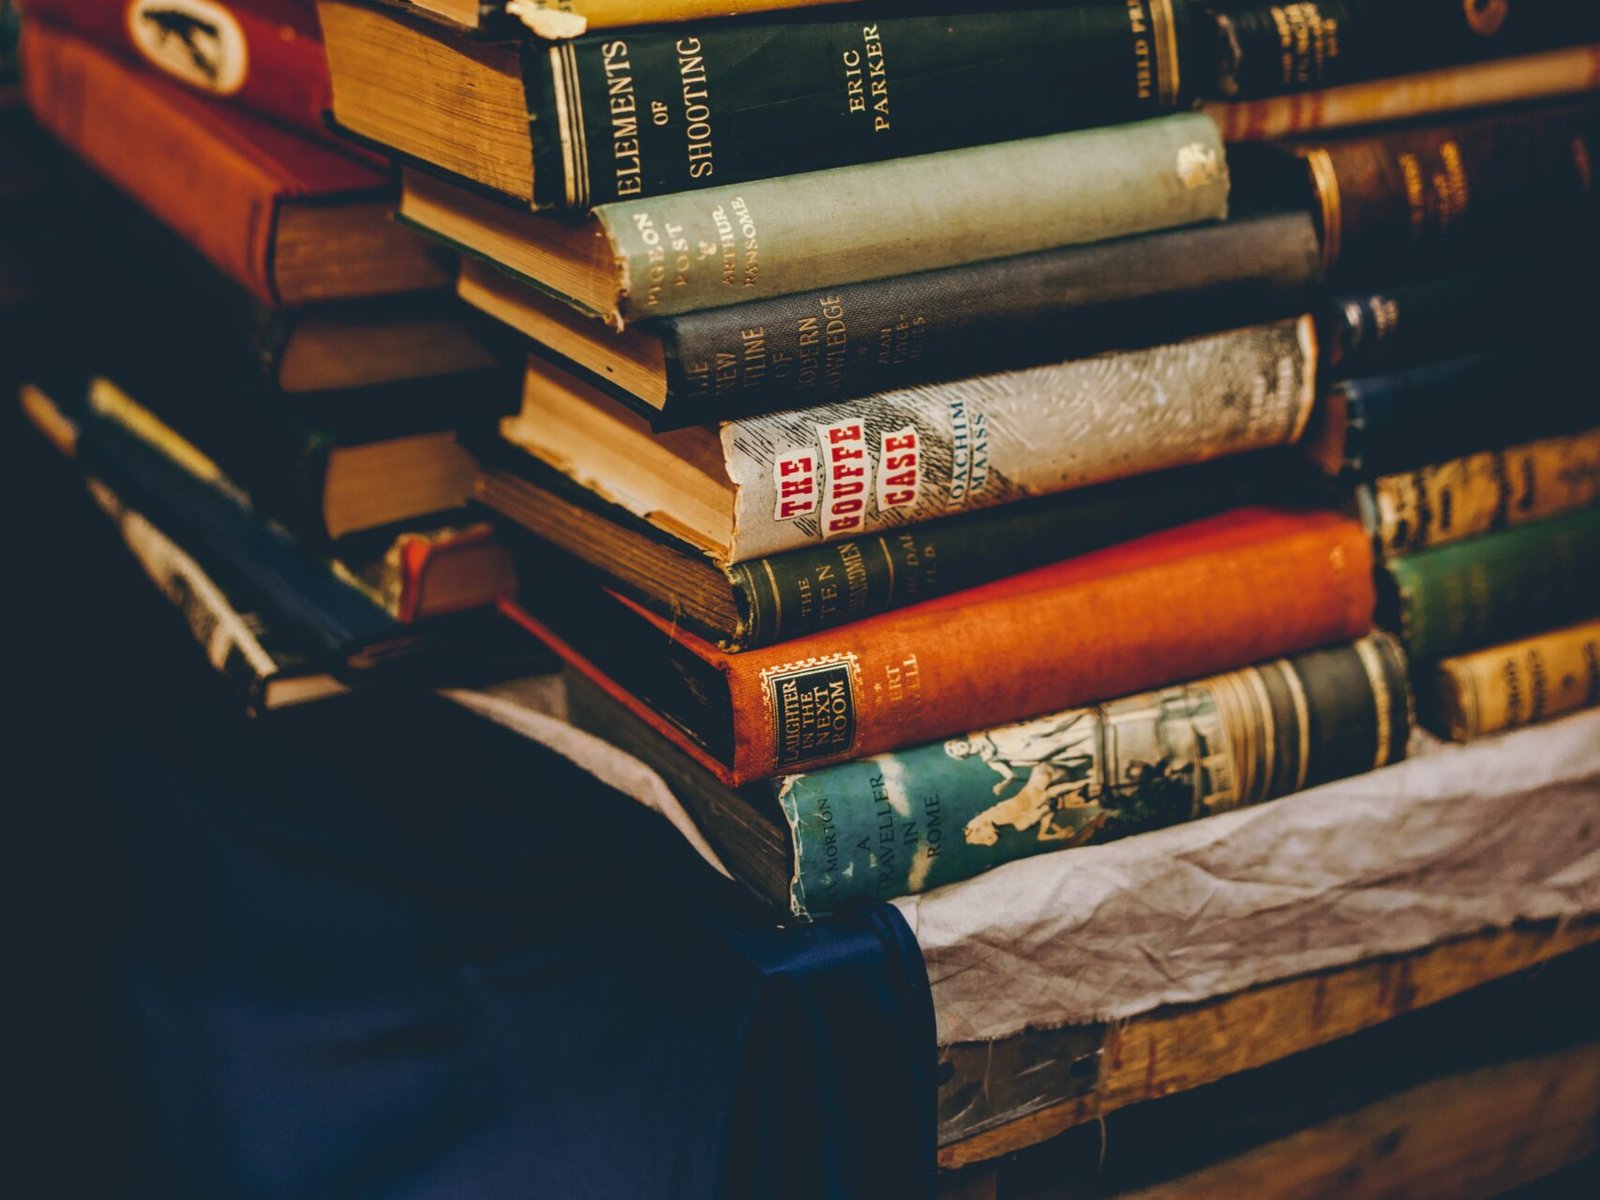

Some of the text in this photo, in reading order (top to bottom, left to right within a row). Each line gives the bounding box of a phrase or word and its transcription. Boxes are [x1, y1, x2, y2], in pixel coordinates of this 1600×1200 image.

[650, 100, 669, 126] OF
[676, 37, 713, 178] SHOOTING
[843, 50, 865, 113] ERIC
[863, 24, 890, 132] PARKER
[601, 40, 641, 196] ELEMENTS
[636, 213, 665, 306] PIGEON
[665, 223, 688, 286] POST
[712, 205, 736, 285] ARTHUR
[731, 197, 758, 288] RANSOME
[779, 457, 813, 518] THE
[825, 425, 864, 532] GOUFFÉ
[883, 434, 916, 505] CASE
[949, 401, 969, 508] JOACHIM
[970, 413, 988, 491] MAASS
[798, 577, 812, 616] THE
[815, 564, 837, 618] TEN
[782, 678, 800, 762] LAUGHTER
[800, 691, 814, 749] IN THE
[814, 686, 831, 745] NEXT
[829, 680, 847, 742] ROOM
[817, 798, 839, 871] MORTON
[855, 836, 871, 851] A
[869, 773, 895, 891] TRAVELLER
[902, 821, 918, 844] IN
[924, 793, 942, 858] ROME
